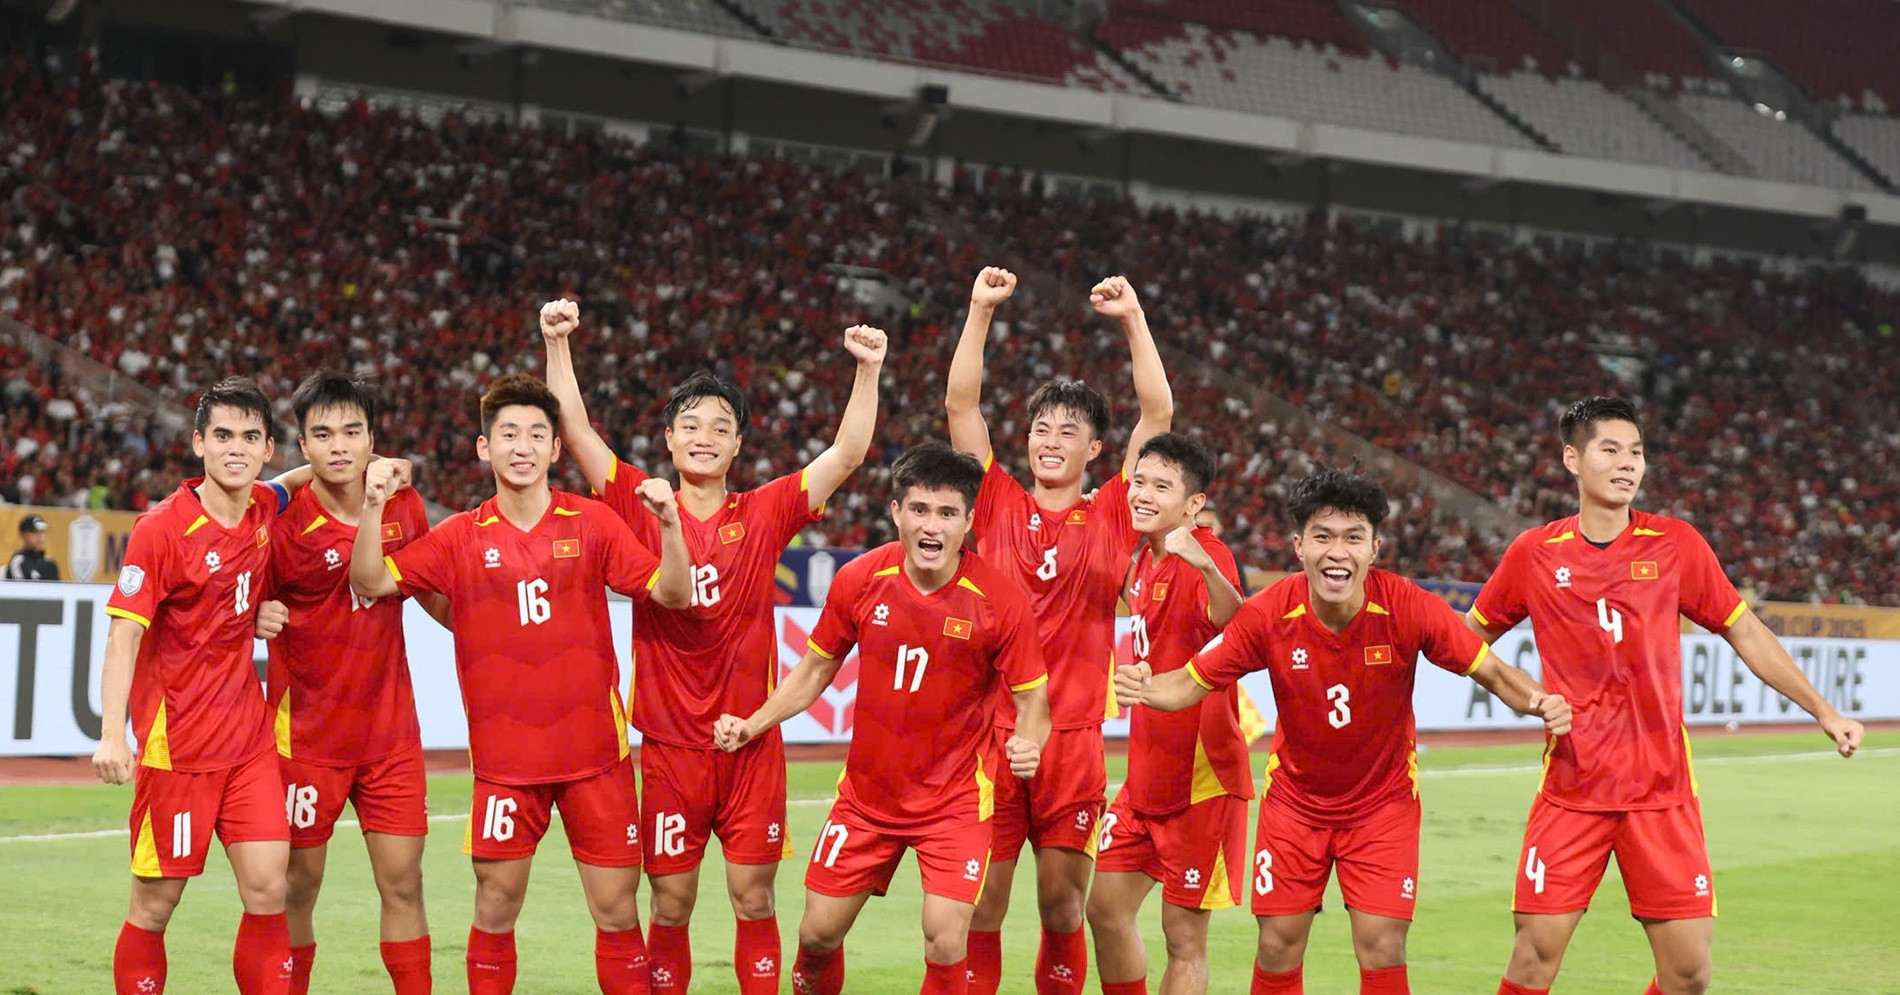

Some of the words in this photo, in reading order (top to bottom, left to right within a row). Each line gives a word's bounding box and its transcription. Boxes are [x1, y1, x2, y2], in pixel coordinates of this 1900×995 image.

[234, 570, 252, 616] 11
[517, 577, 551, 627] 16
[689, 562, 721, 608] 12
[1596, 597, 1623, 643] 4
[893, 644, 929, 694] 17
[1326, 683, 1352, 729] 3
[285, 783, 319, 829] 18
[482, 794, 518, 842] 16
[173, 811, 191, 858] 11
[654, 811, 686, 857] 12
[813, 819, 849, 868] 17
[1255, 848, 1274, 896] 3
[1525, 846, 1546, 894] 4
